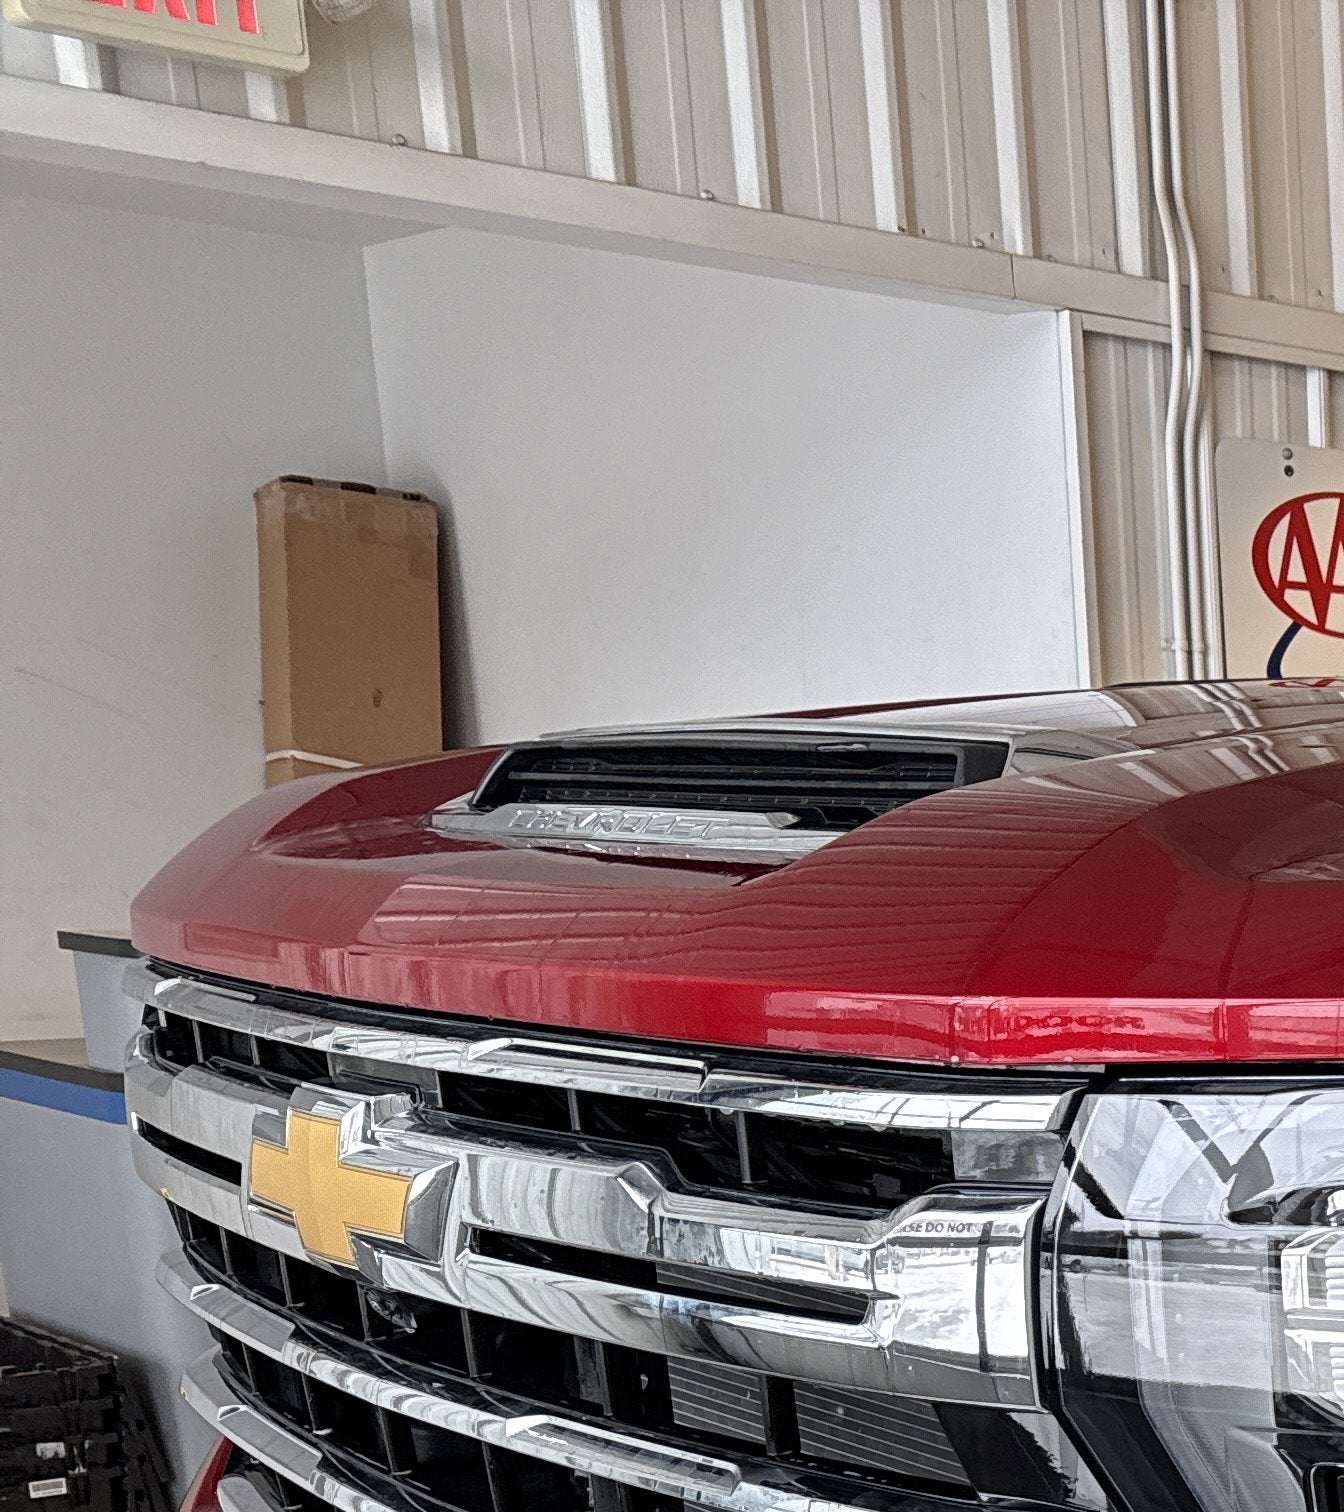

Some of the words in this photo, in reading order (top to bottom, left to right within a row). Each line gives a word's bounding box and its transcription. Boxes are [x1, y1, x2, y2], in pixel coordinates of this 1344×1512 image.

[507, 806, 730, 839] CHEVROLET
[925, 1222, 944, 1233] DO
[947, 1222, 974, 1233] NOT
